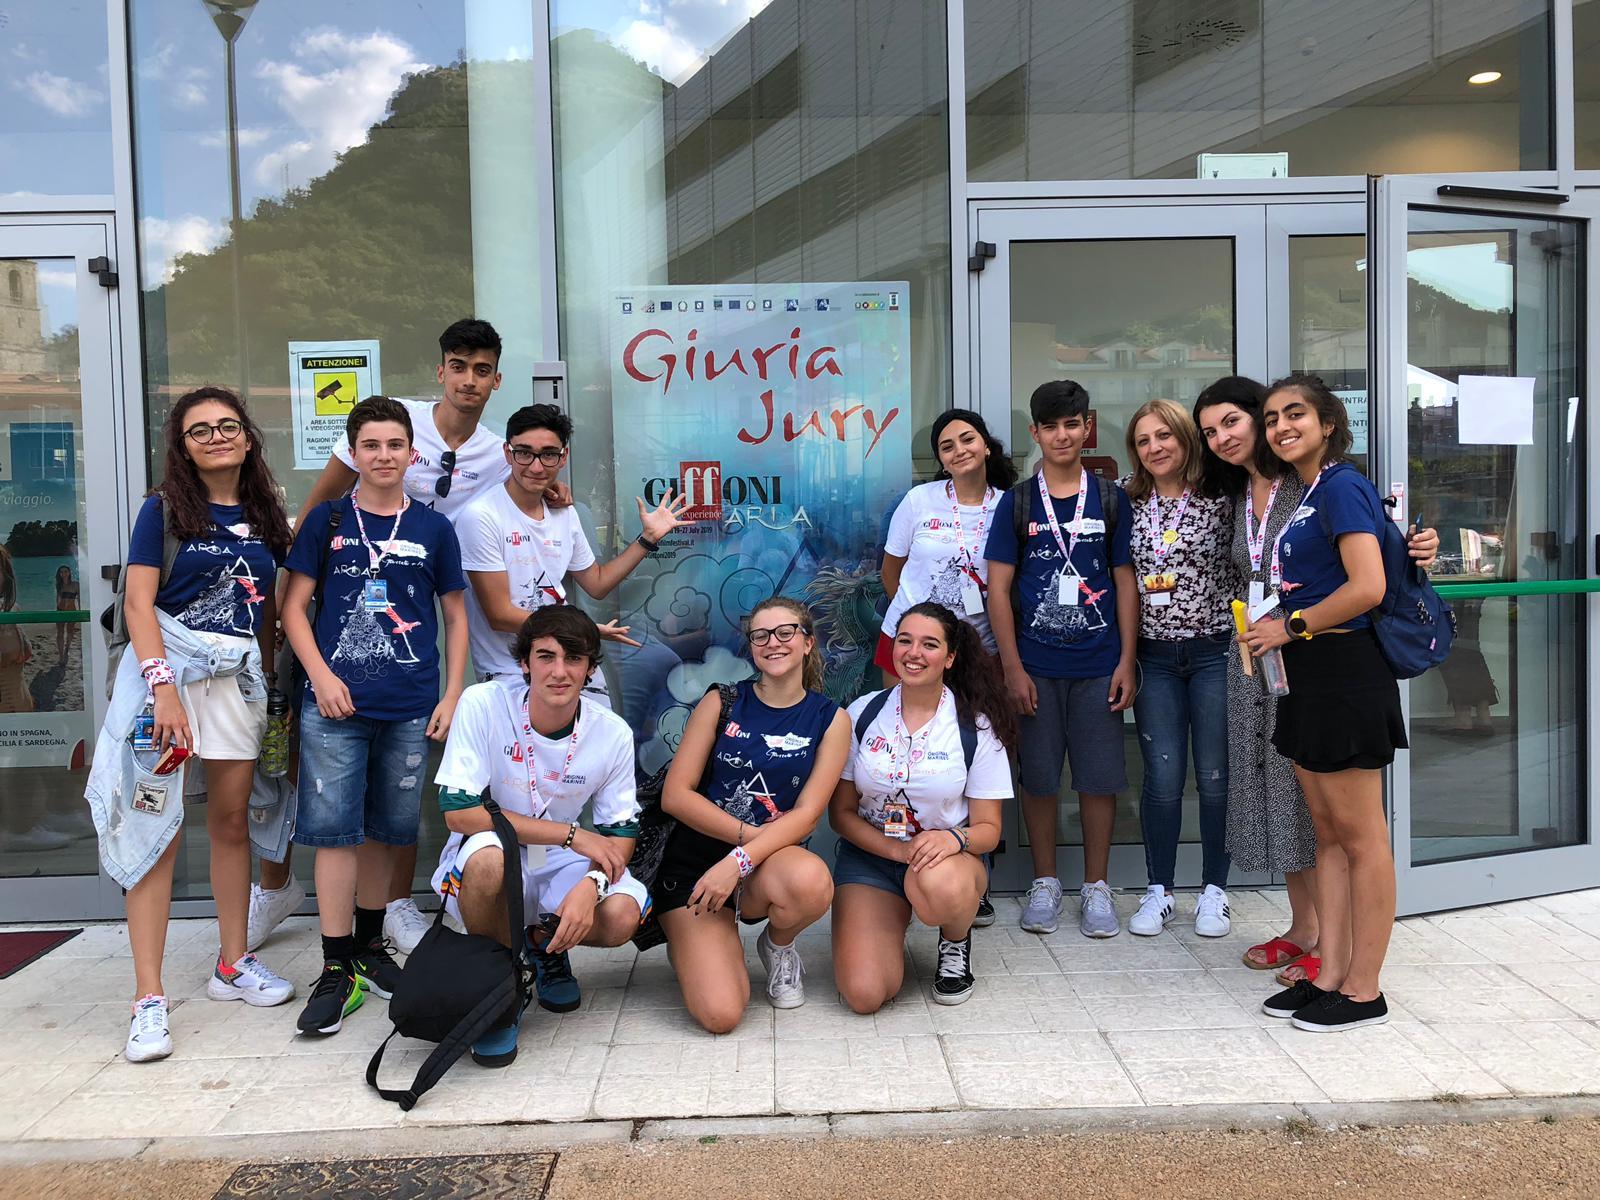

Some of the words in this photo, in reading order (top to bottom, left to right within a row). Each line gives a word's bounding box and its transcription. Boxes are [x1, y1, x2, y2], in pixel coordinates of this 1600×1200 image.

[306, 358, 363, 368] ATTENZIONE!
[623, 326, 843, 395] Giuria
[737, 389, 899, 460] Jury
[3, 491, 55, 508] viaggio.
[681, 509, 722, 521] experience
[724, 505, 813, 530] ARIA
[20, 729, 52, 737] SPAGNA,
[25, 738, 68, 746] SARDEGNA.
